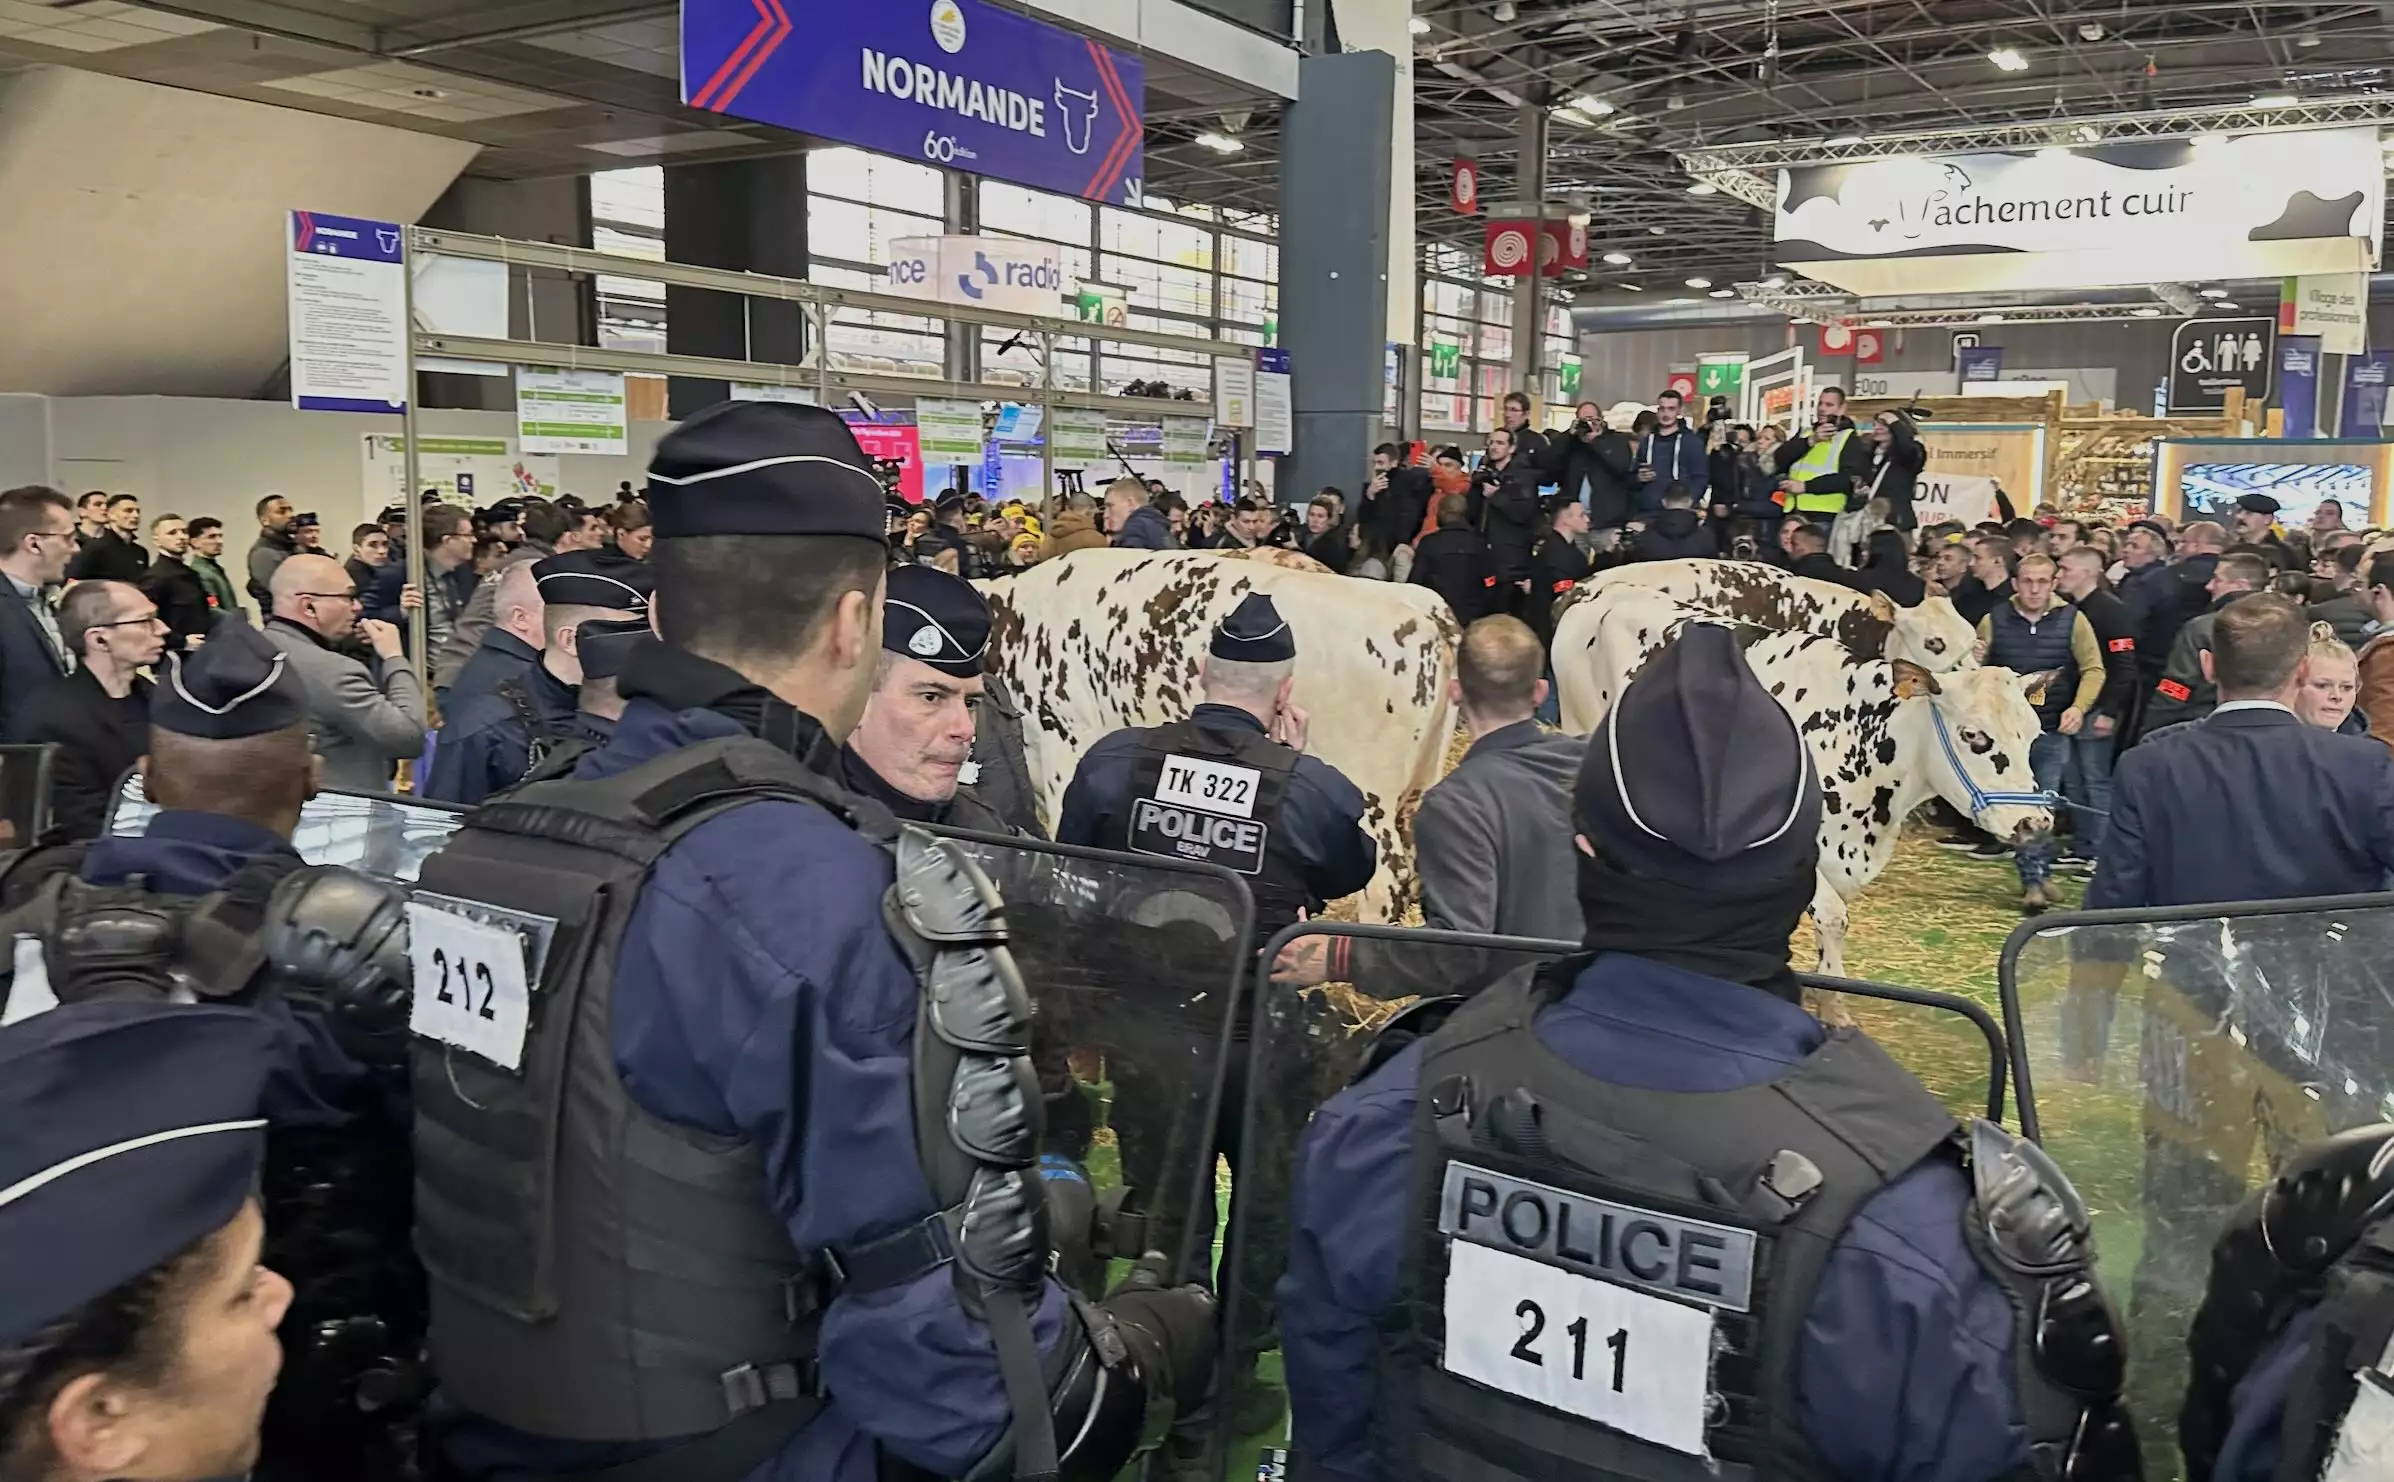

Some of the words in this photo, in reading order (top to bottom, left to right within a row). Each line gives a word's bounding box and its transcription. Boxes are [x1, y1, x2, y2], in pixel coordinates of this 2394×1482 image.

[862, 47, 1046, 138] NORMANDE
[2122, 184, 2195, 215] cuir
[1936, 447, 1998, 460] Immersif
[1167, 767, 1196, 794] TK
[1203, 773, 1249, 804] 322
[1137, 803, 1260, 854] POLICE
[433, 947, 496, 1021] 212
[1458, 1176, 1727, 1296] POLICE
[1509, 1299, 1629, 1394] 211
